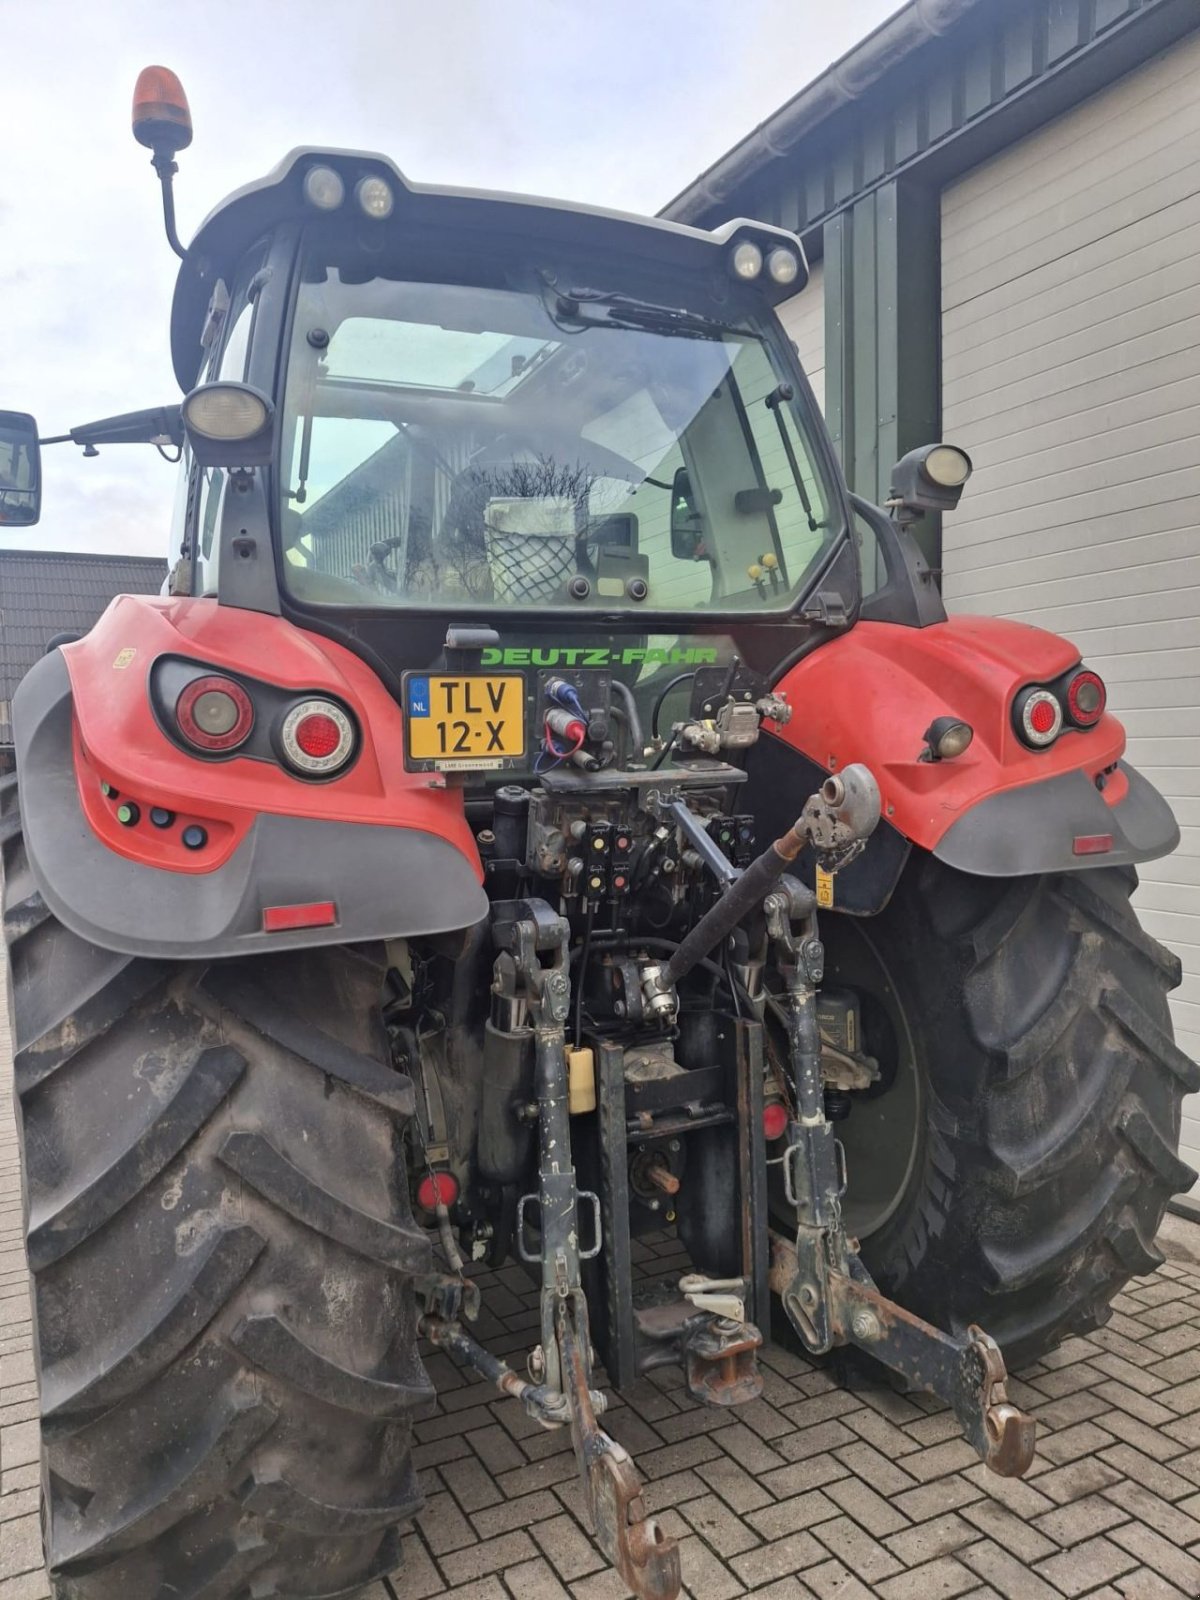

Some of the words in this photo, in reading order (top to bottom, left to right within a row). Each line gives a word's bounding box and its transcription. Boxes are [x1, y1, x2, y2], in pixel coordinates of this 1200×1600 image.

[480, 648, 718, 666] DEUTZ-FAHR
[413, 702, 427, 712] NL
[440, 682, 506, 714] TLV
[437, 721, 505, 753] 12-X
